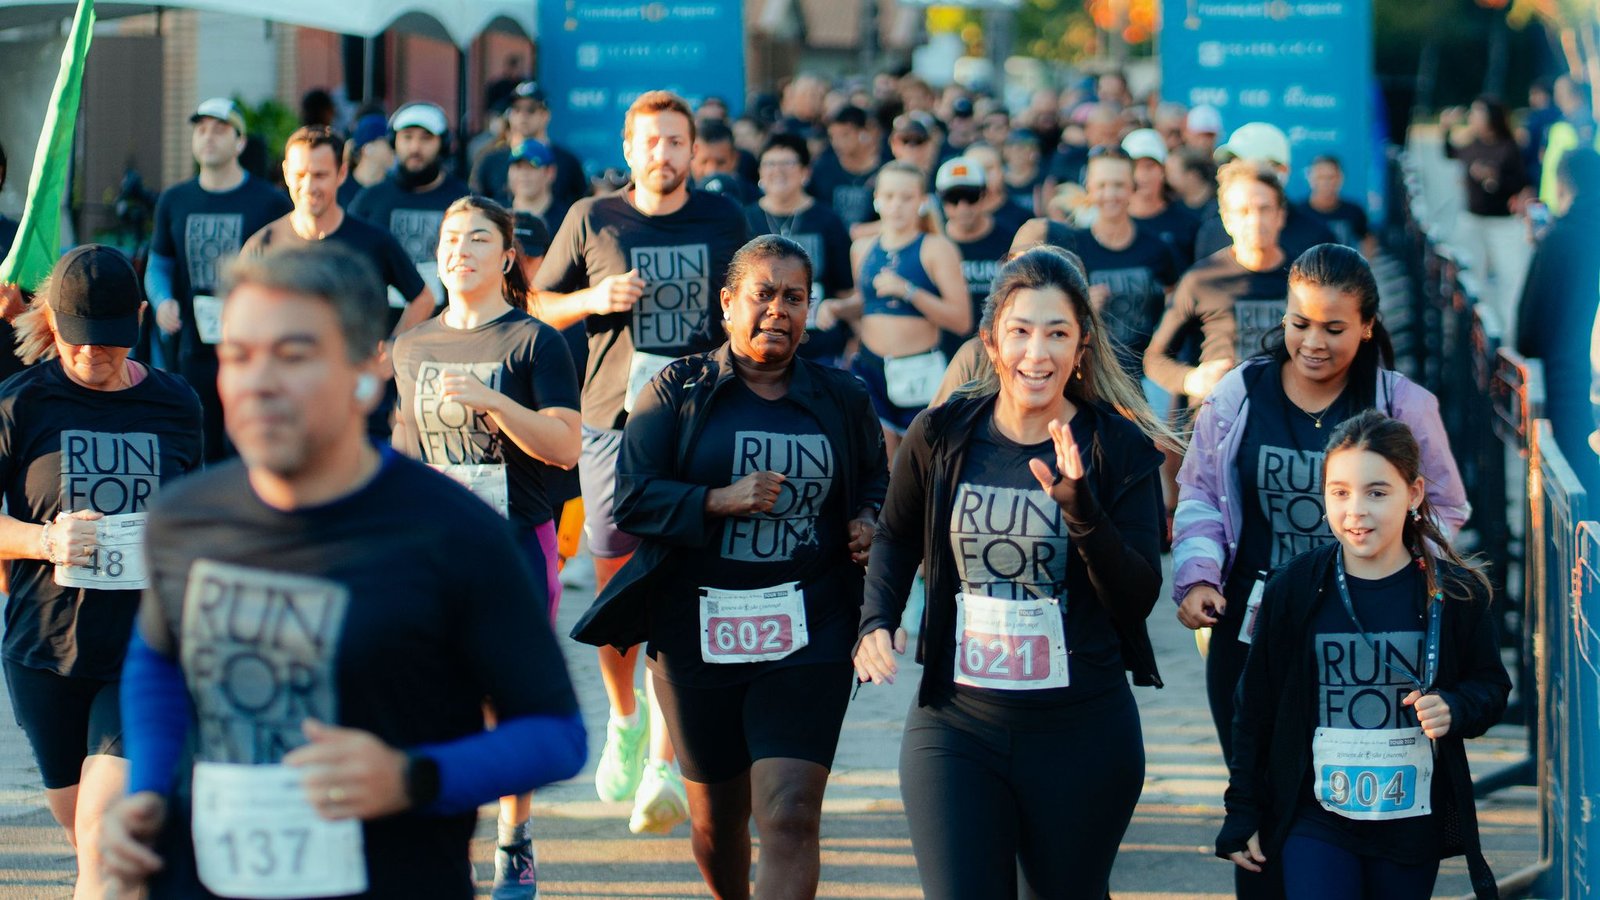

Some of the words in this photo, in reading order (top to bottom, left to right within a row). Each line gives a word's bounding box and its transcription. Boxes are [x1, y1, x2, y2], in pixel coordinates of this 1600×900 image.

[190, 220, 237, 240] RUN
[637, 249, 704, 281] RUN
[638, 281, 701, 312] FOR
[639, 313, 707, 345] FUN
[420, 367, 496, 395] RN
[420, 397, 493, 432] FOR
[67, 436, 155, 475] RUN
[425, 431, 500, 465] FUN
[740, 437, 829, 478] RUN
[1264, 452, 1324, 493] RU
[69, 476, 153, 516] FOR
[760, 480, 823, 518] OR
[957, 490, 1061, 537] RUN
[1267, 493, 1333, 534] FO
[727, 517, 812, 558] FUN
[80, 549, 124, 578] 48
[958, 537, 1056, 582] FOR
[198, 576, 335, 655] RUN
[715, 620, 782, 651] 602
[965, 637, 1033, 677] 621
[1323, 639, 1423, 686] RUN
[193, 645, 318, 713] FOR
[1326, 688, 1418, 730] FOR
[1329, 770, 1407, 807] 904
[218, 827, 312, 877] 137
